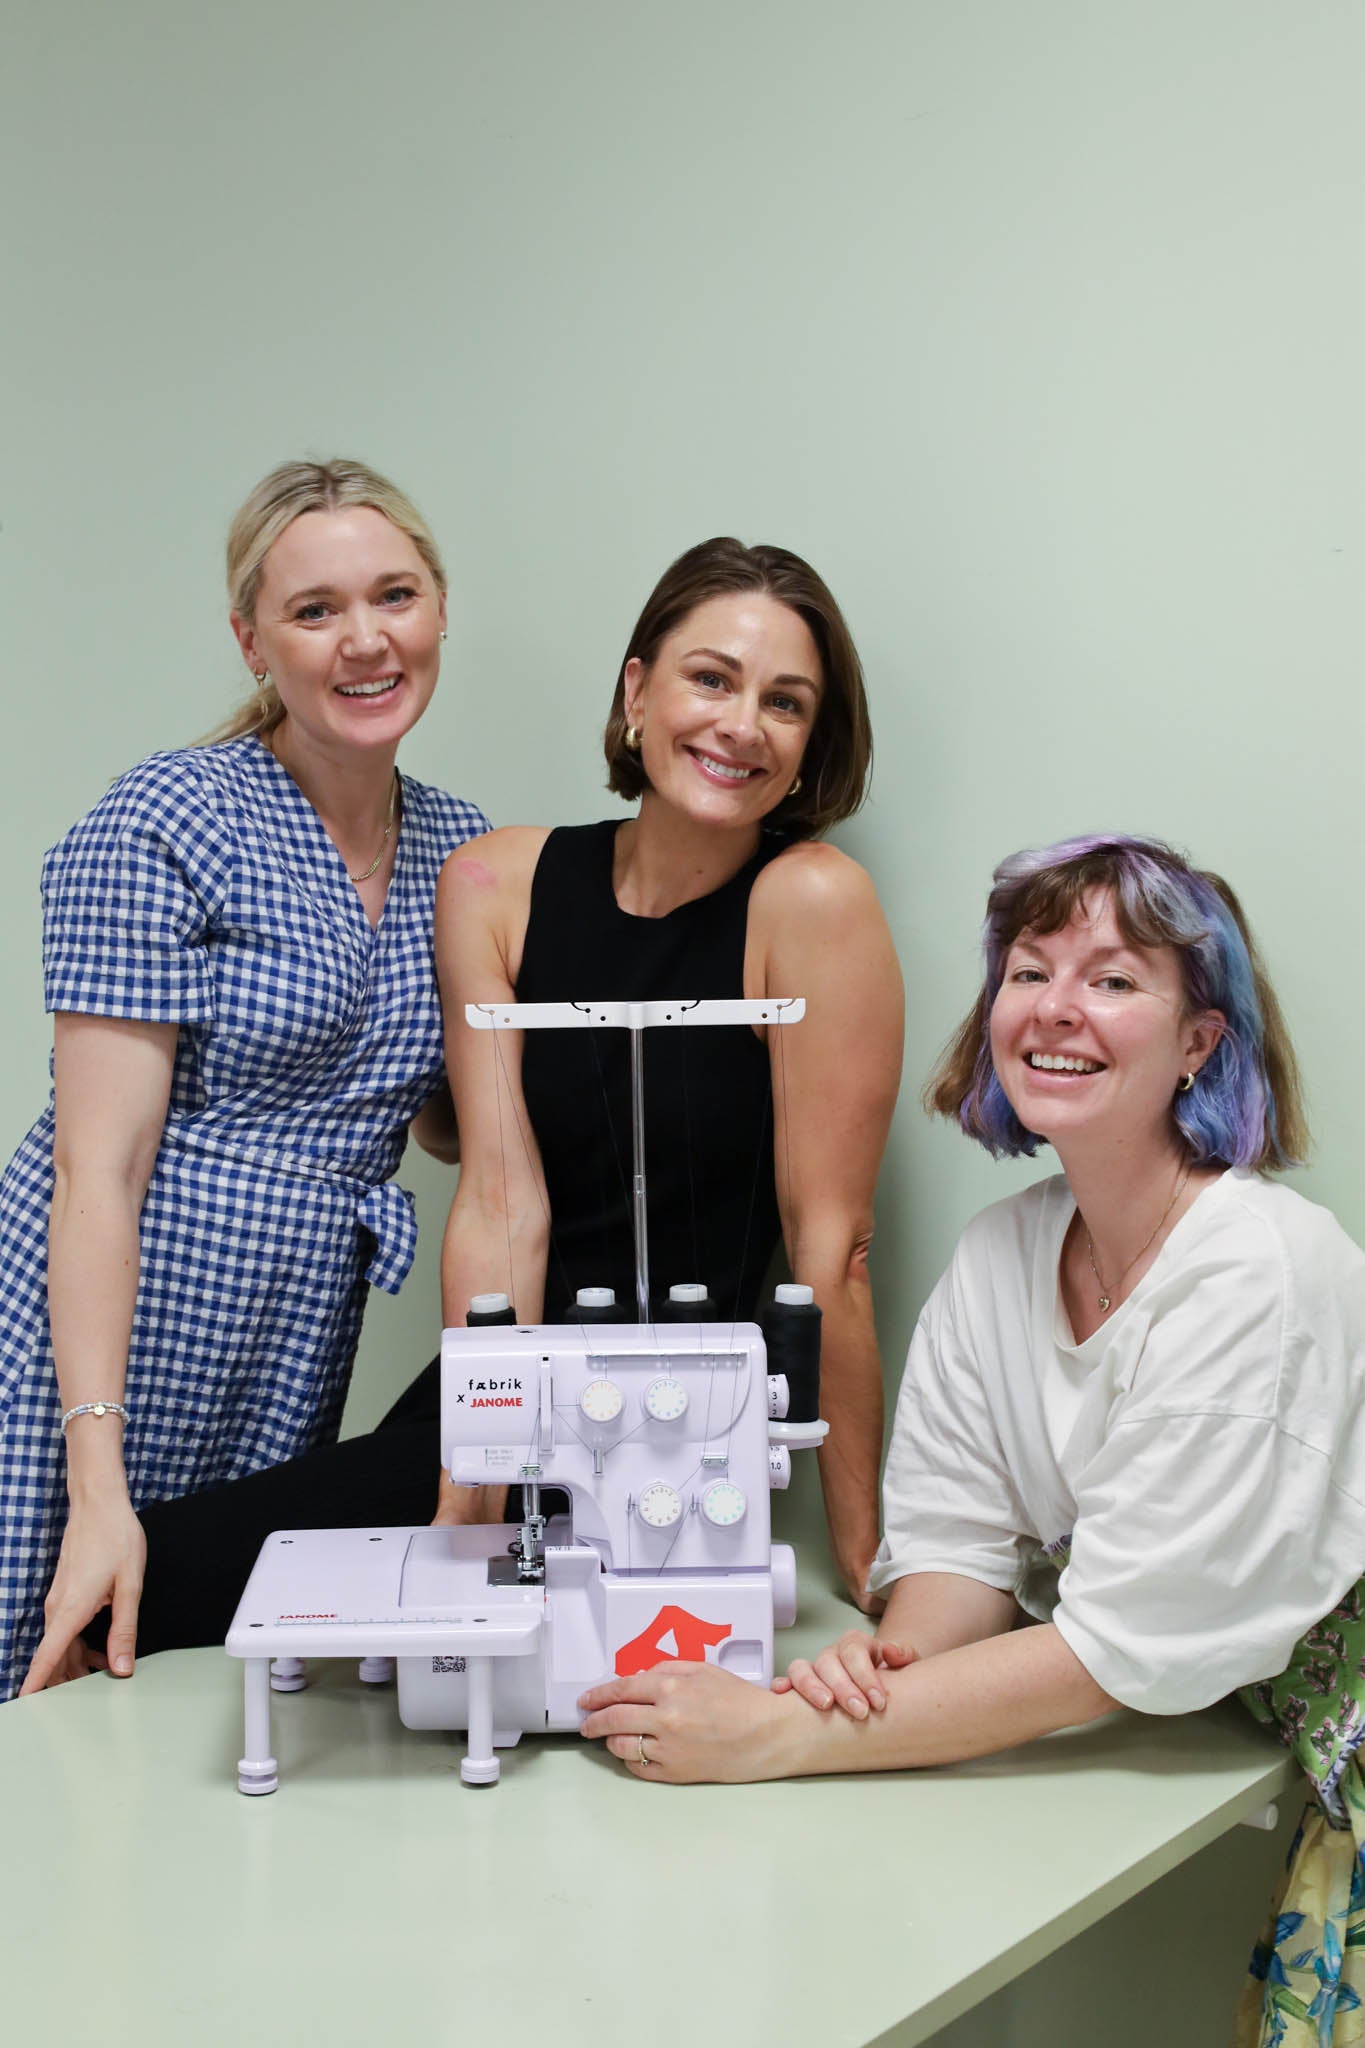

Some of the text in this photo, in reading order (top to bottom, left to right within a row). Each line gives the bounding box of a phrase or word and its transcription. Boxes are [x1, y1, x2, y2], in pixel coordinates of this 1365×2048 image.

[771, 1391, 778, 1400] 3
[470, 1397, 523, 1408] JANOME
[770, 1462, 782, 1470] 1.0
